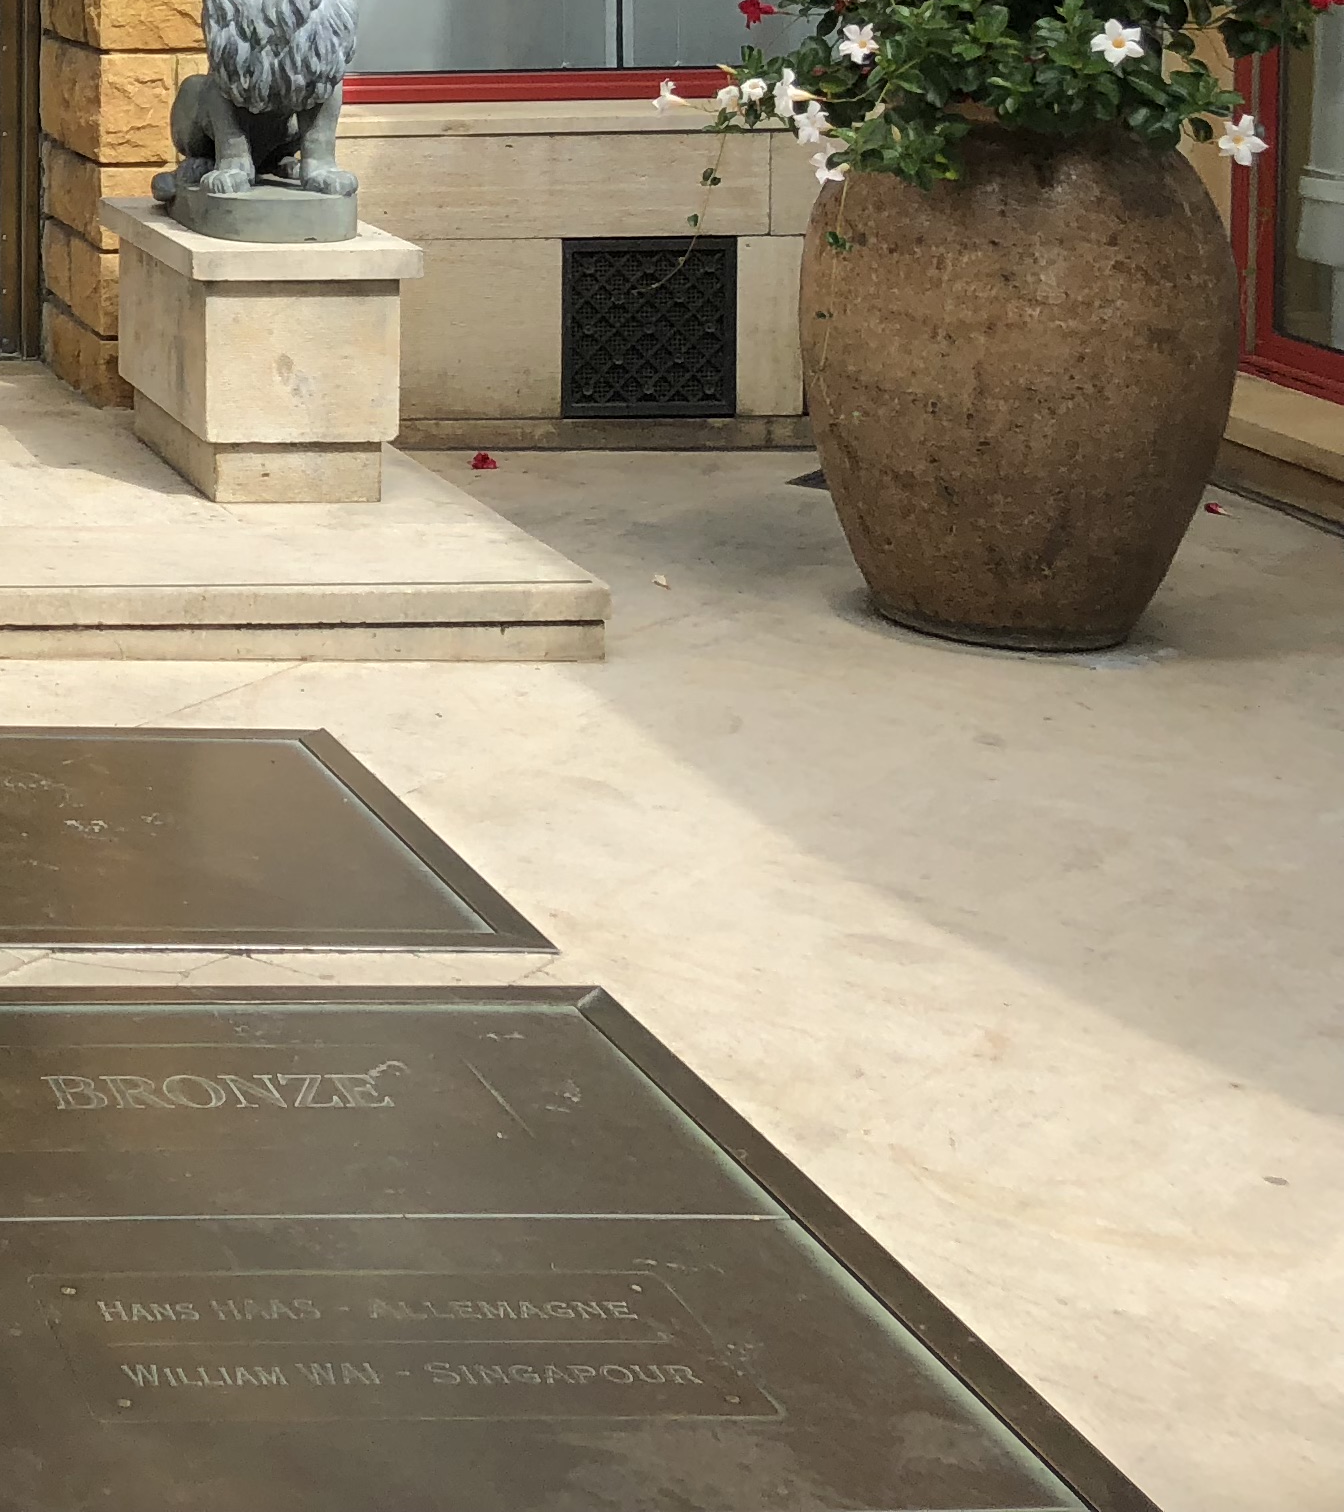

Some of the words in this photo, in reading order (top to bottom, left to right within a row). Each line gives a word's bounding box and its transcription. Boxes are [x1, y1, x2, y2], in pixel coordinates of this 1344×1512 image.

[40, 1074, 395, 1110] BRONZE
[96, 1300, 200, 1321] HANS
[211, 1298, 321, 1320] HAAS
[370, 1299, 639, 1320] ALLEMAGNE
[120, 1363, 289, 1386] WILLIAM
[294, 1362, 383, 1386] WAI
[423, 1362, 704, 1385] SINGAPOUR
